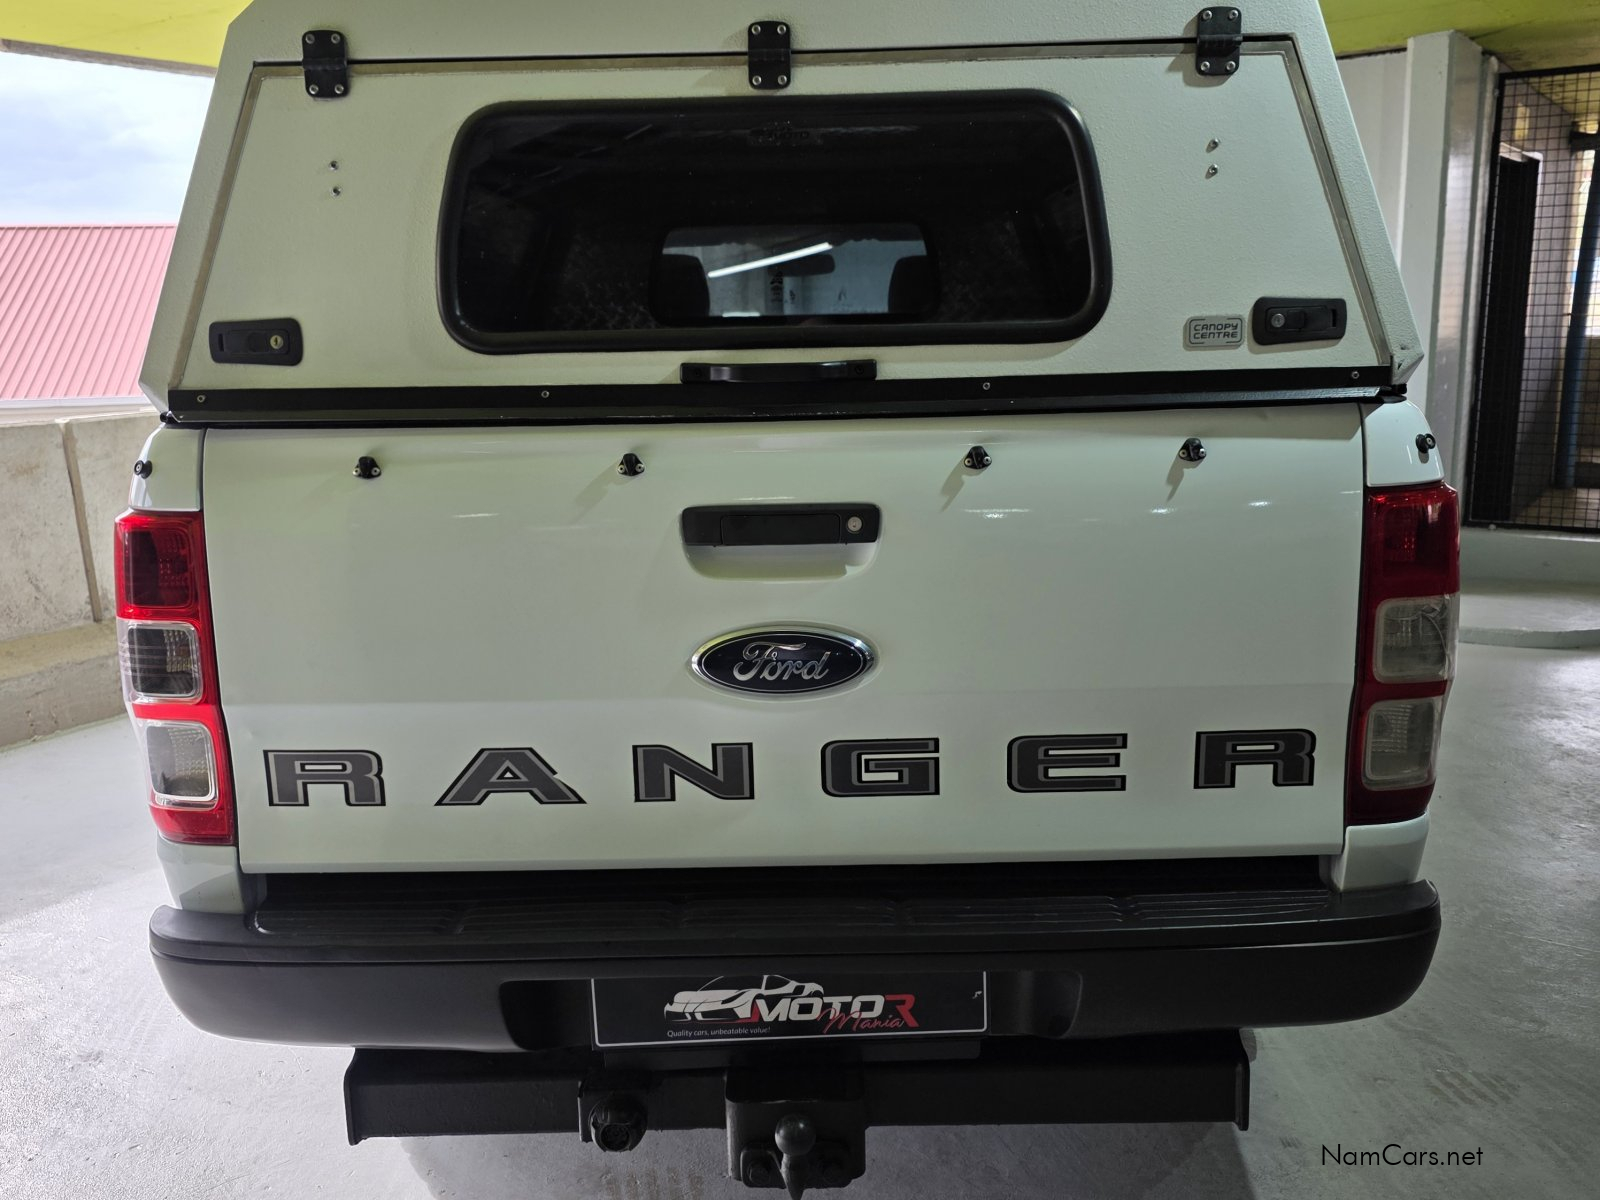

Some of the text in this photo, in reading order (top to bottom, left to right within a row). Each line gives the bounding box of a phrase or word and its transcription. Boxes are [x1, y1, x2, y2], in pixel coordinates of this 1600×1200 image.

[1193, 323, 1238, 332] CANOPY
[1193, 331, 1238, 340] CENTRE
[733, 641, 831, 681] Ford
[263, 728, 1317, 807] RANGER
[818, 1007, 904, 1034] Mania
[667, 1029, 692, 1038] Quality
[710, 1027, 749, 1035] unbeatable
[750, 1026, 771, 1034] value!
